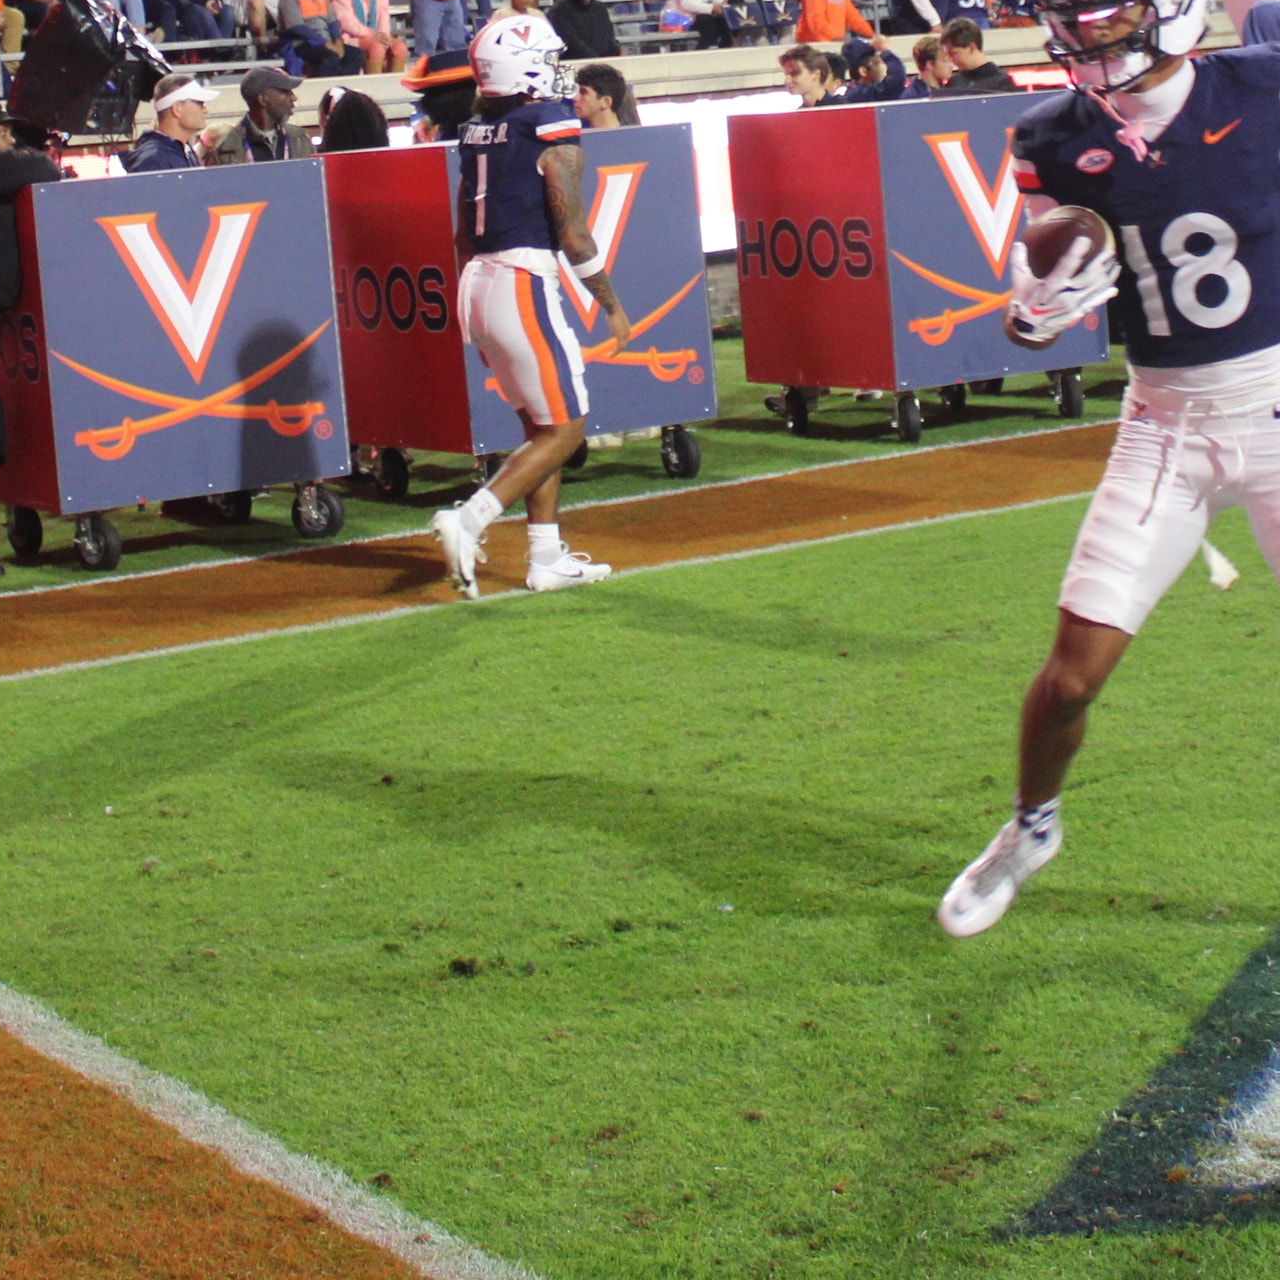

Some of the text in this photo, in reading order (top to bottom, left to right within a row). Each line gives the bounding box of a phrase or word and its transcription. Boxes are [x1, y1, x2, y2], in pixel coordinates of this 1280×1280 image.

[511, 25, 531, 46] V
[475, 153, 487, 234] 1
[922, 128, 1027, 282] V
[94, 201, 269, 384] V
[740, 216, 873, 279] HOOS
[1120, 212, 1252, 337] 18
